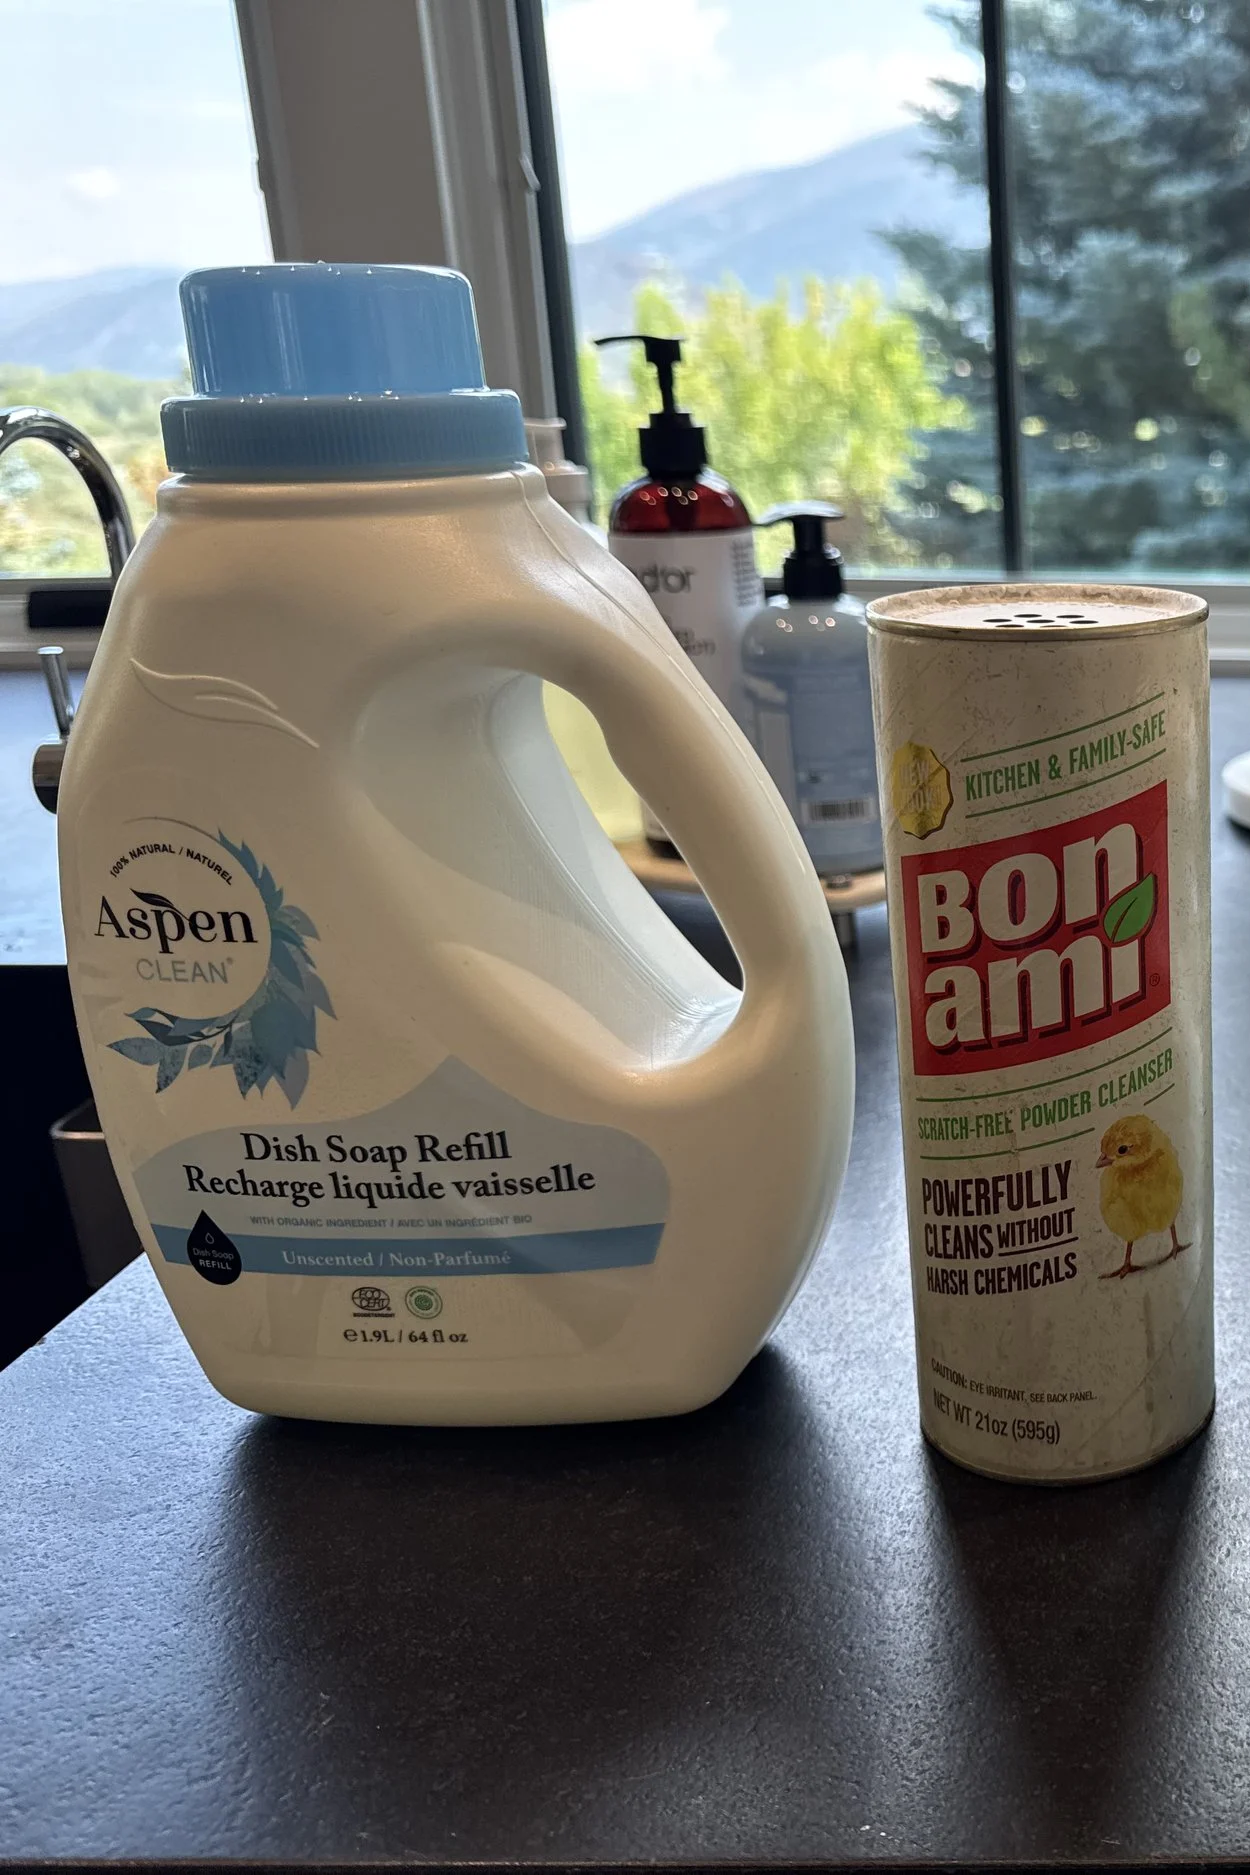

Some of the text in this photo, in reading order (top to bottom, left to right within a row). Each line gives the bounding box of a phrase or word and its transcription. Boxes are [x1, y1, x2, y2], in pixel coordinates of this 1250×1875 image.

[965, 708, 1167, 801] KITCHEN & FAMILY-SAFE
[109, 855, 130, 878] 100%
[128, 843, 176, 860] NATURAL
[186, 848, 234, 886] NATUREL
[917, 822, 1140, 957] Bon
[94, 895, 259, 954] Aspen
[924, 934, 1142, 1049] ami
[917, 1047, 1173, 1141] SCRATCH-FREE POWDER CLEANSER
[239, 1130, 513, 1173] Dish Soap Refill
[182, 1163, 596, 1209] Recharge liquide vaisselle
[921, 1159, 1072, 1217] POWERFULLY
[250, 1215, 276, 1226] WITH
[277, 1216, 323, 1228] ORGANIC
[326, 1218, 388, 1229] INGREDIENT
[397, 1218, 425, 1229] AVEC
[427, 1218, 443, 1229] UN
[513, 1214, 533, 1225] BIO
[924, 1206, 1076, 1260] CLEANS WITHOUT
[192, 1247, 235, 1261] Dish Soap
[199, 1259, 232, 1271] REFILL
[281, 1250, 375, 1267] Unscented
[388, 1249, 512, 1267] Non-Parfumé
[926, 1251, 1078, 1296] HARSH CHEMICALS
[408, 1330, 429, 1343] 64
[432, 1328, 445, 1343] fl
[448, 1333, 469, 1343] oz
[931, 1357, 968, 1390] CAUTION:
[969, 1379, 985, 1395] EYE
[1029, 1392, 1045, 1403] SEE
[1046, 1392, 1069, 1403] BACK
[1069, 1390, 1098, 1403] PANEL.
[933, 1387, 1061, 1445] NET WT 21oz (595g)
